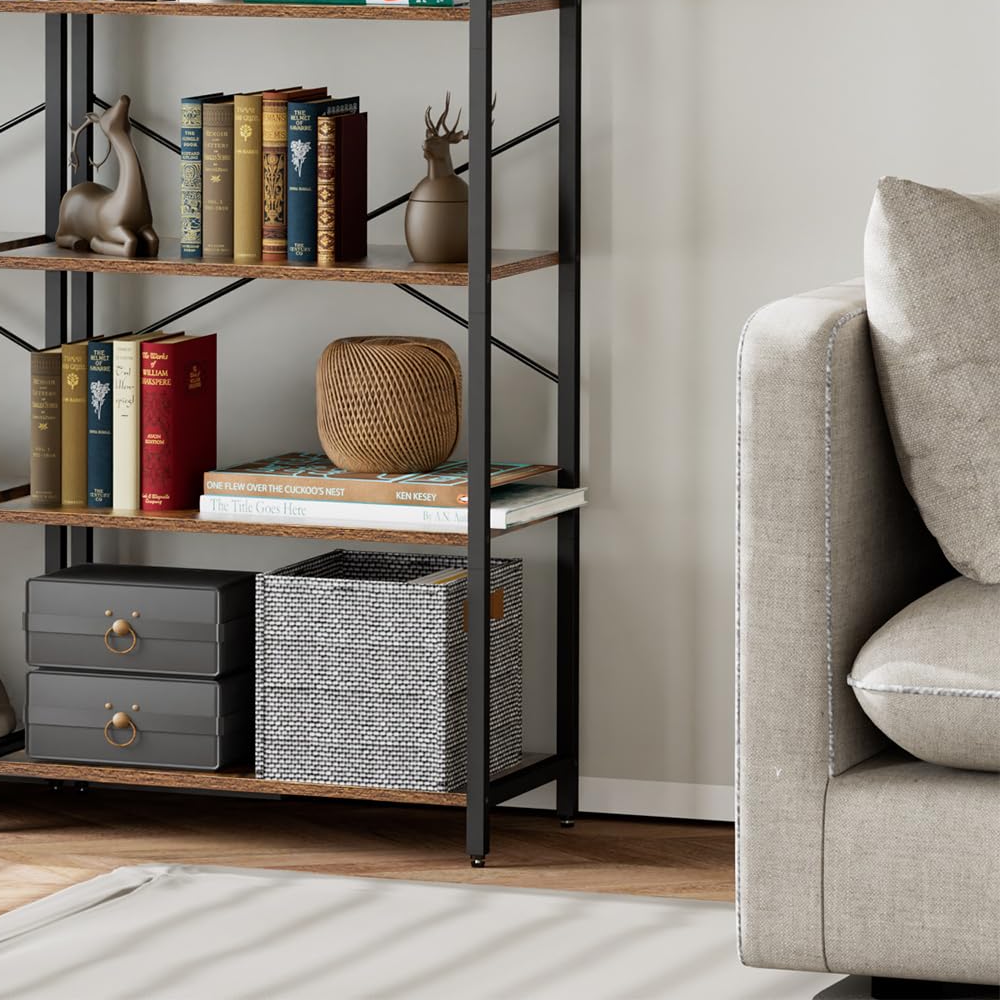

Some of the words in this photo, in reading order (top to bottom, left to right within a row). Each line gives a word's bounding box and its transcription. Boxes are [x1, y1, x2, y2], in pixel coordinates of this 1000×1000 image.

[150, 360, 157, 369] of
[142, 369, 169, 377] WILLIAM
[206, 480, 223, 490] ONE
[224, 482, 246, 491] FLEW
[246, 483, 267, 493] OVER
[267, 484, 284, 493] THE
[284, 485, 325, 496] CUCKOO'S
[325, 487, 345, 497] NEST
[395, 491, 412, 500] KEN
[412, 492, 437, 502] KESEY
[210, 498, 229, 512] The
[231, 499, 253, 513] Title
[255, 501, 280, 514] Goes
[283, 502, 306, 516] Here
